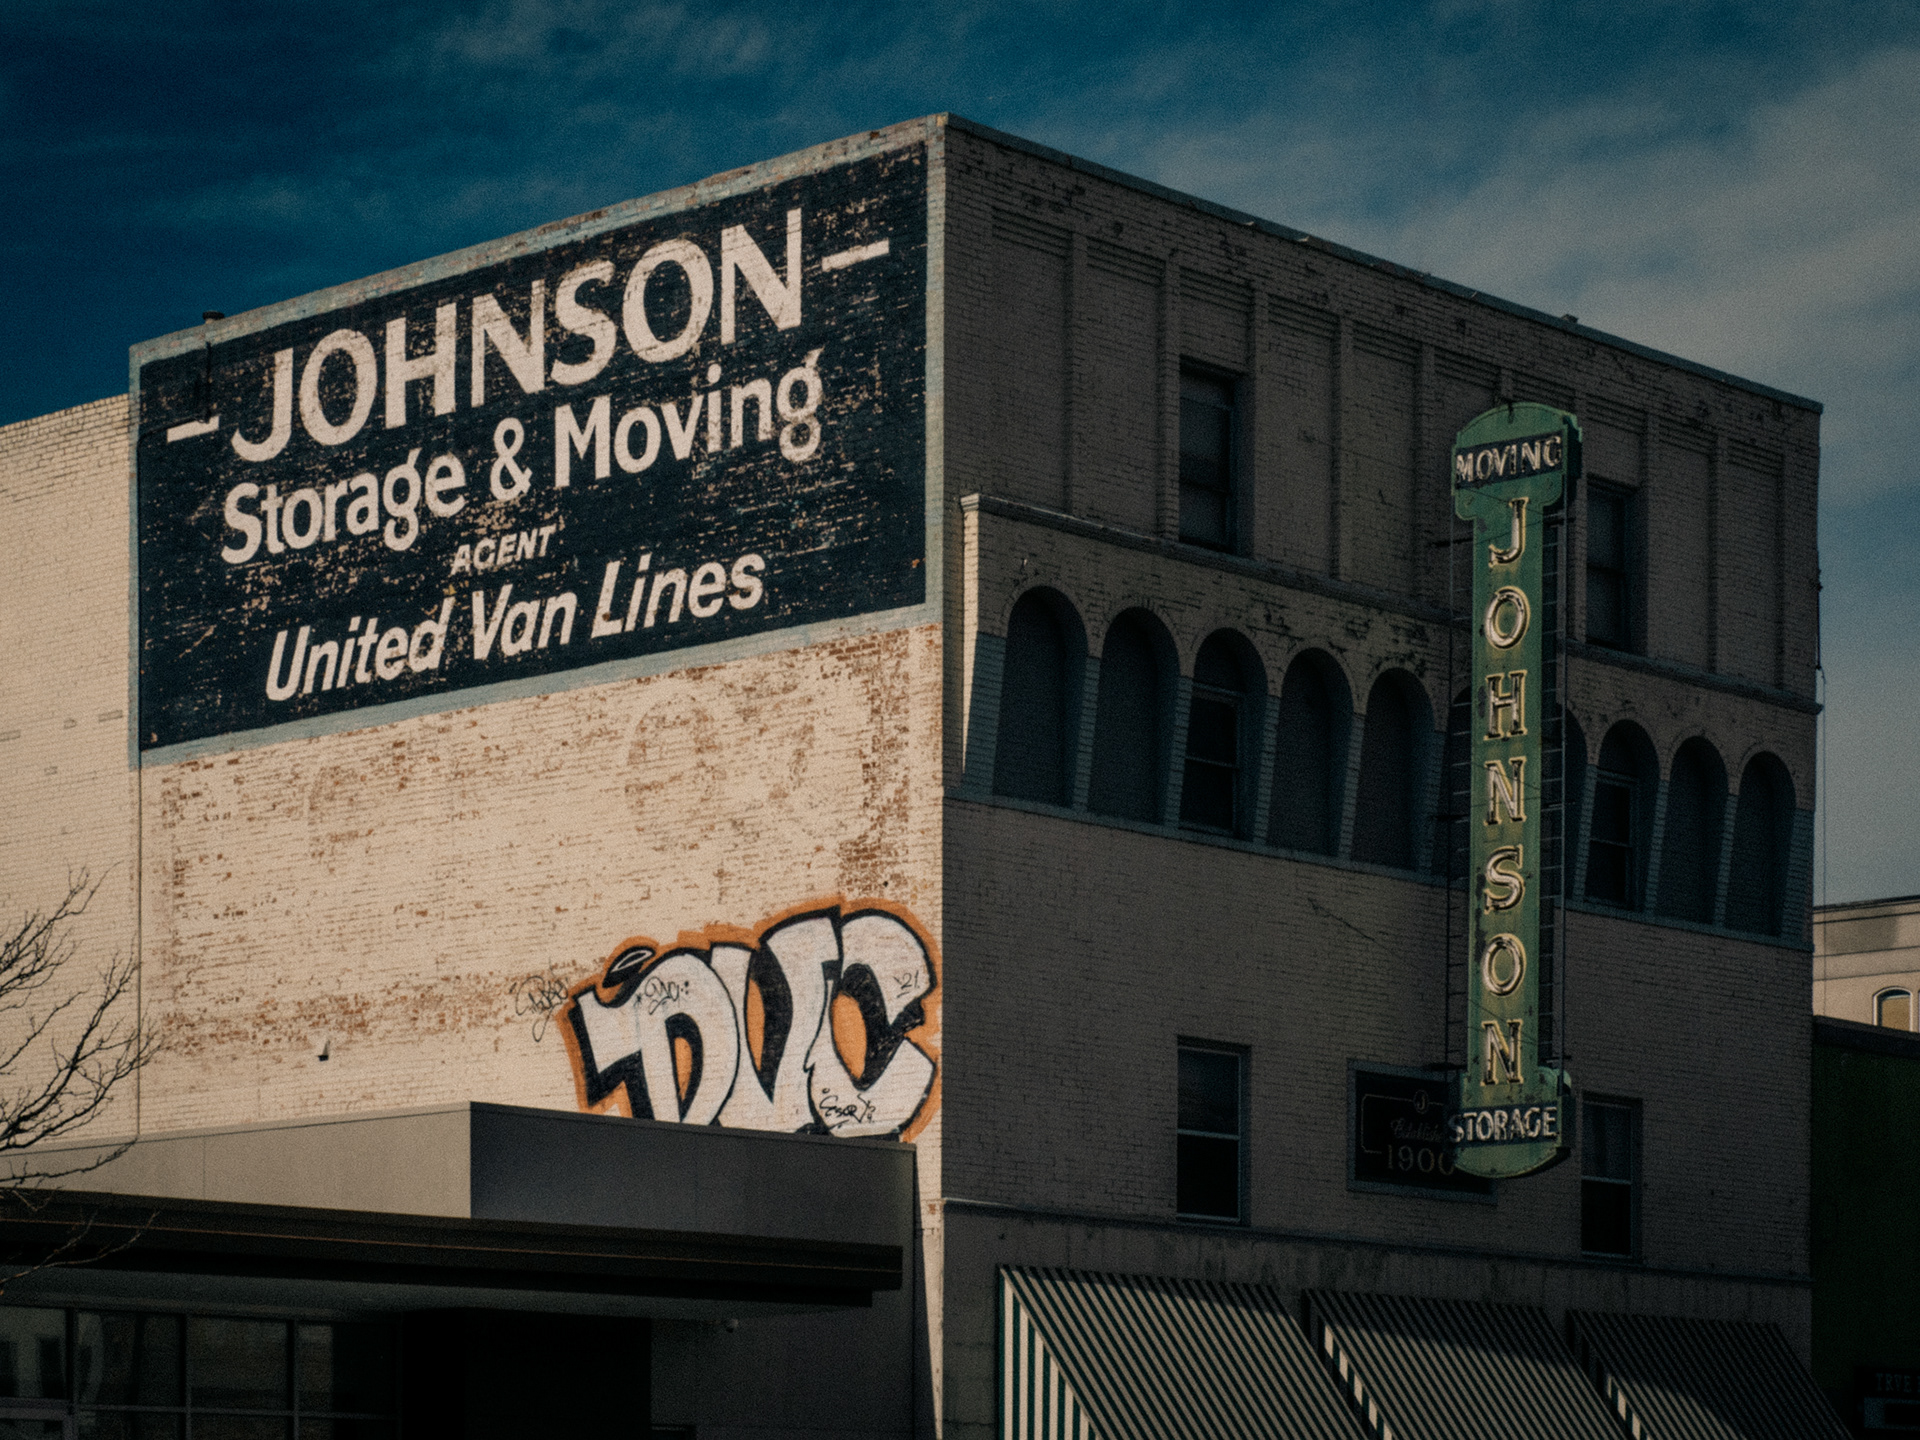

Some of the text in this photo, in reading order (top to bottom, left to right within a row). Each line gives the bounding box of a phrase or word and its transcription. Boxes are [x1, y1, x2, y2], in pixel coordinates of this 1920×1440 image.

[221, 344, 825, 564] Storage & Moving
[1455, 435, 1562, 483] MOVING
[449, 524, 556, 577] AGENT
[266, 553, 766, 701] United Van Lines
[1479, 497, 1531, 1087] JOHNSON
[1449, 1106, 1559, 1143] STORAGE
